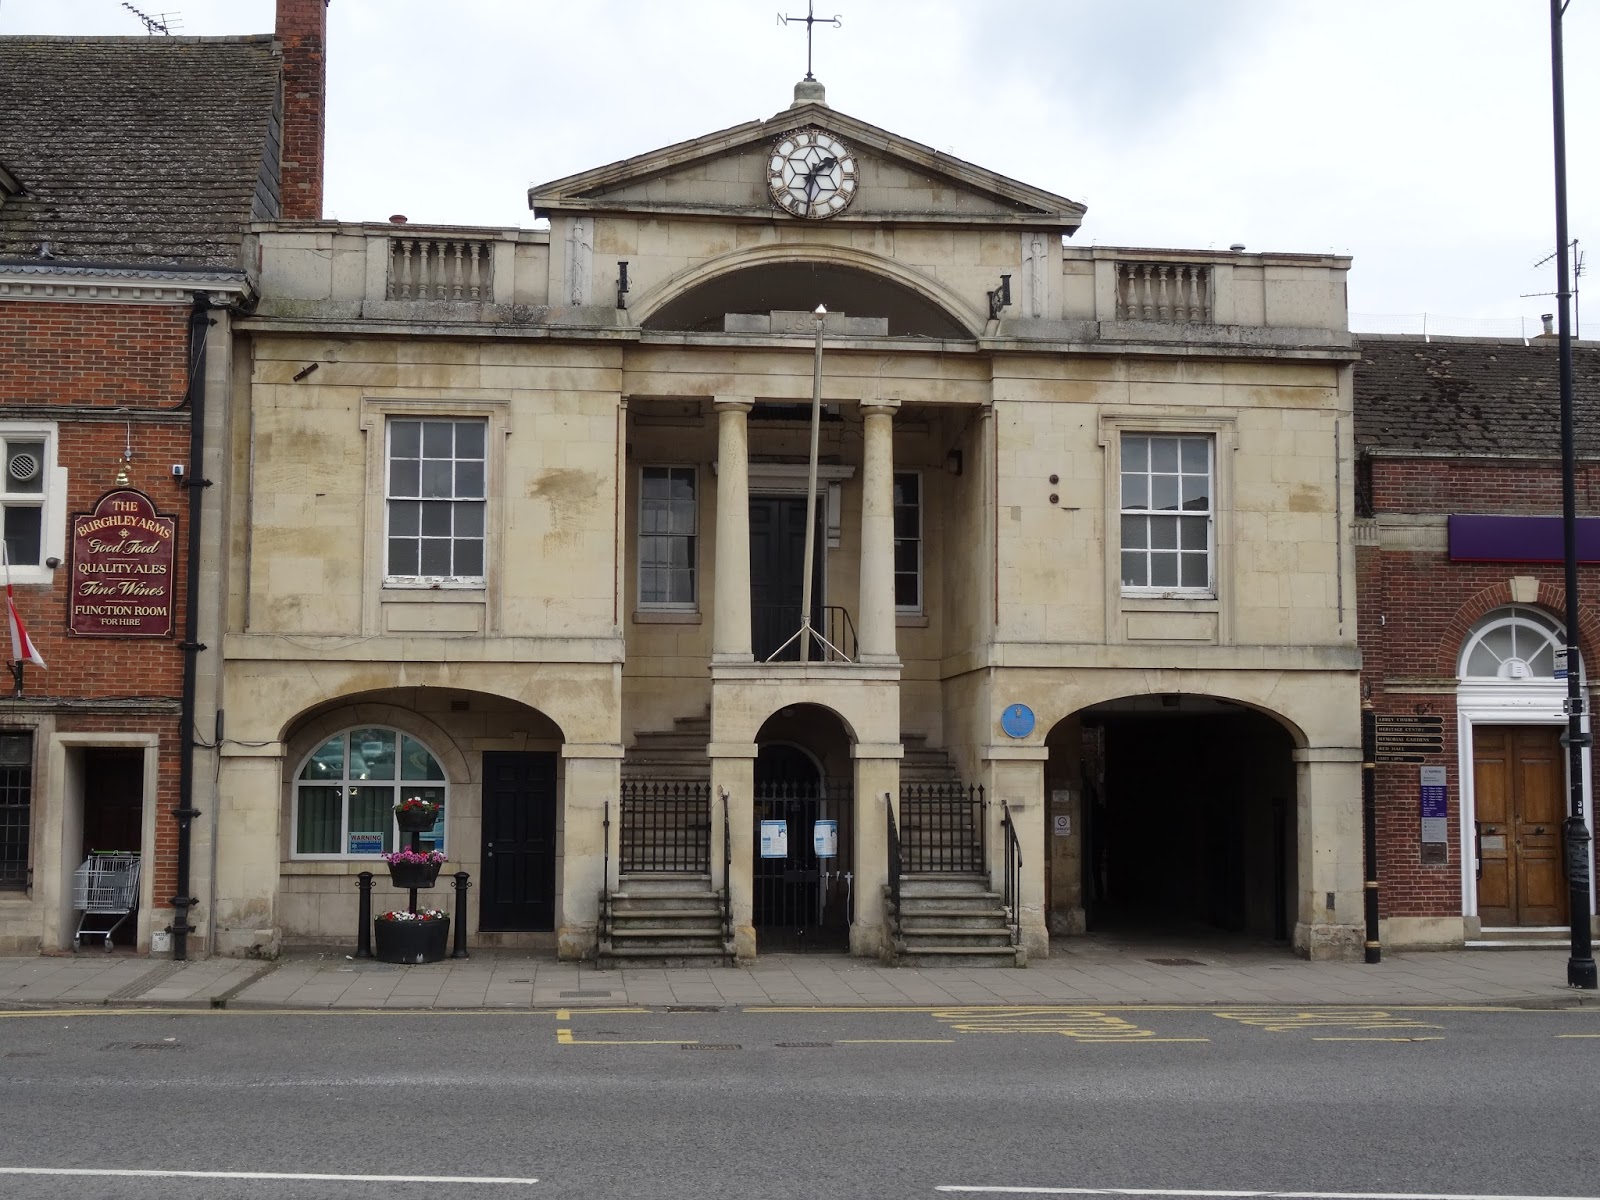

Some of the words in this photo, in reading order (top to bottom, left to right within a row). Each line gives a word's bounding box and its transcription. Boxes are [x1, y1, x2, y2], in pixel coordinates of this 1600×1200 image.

[777, 13, 787, 26] N
[833, 15, 842, 28] S
[112, 502, 138, 511] THE
[77, 515, 139, 536] BURGHLEY
[138, 518, 172, 538] ARMS
[88, 537, 125, 554] Good
[122, 540, 160, 554] Food
[79, 563, 133, 575] QUALITY
[134, 564, 167, 574] ALES
[78, 581, 117, 596] Fine
[118, 582, 166, 596] Wines
[75, 606, 132, 615] FUNCTION
[134, 606, 167, 616] ROOM
[120, 618, 140, 626] HIRE
[932, 1011, 1155, 1037] STOP
